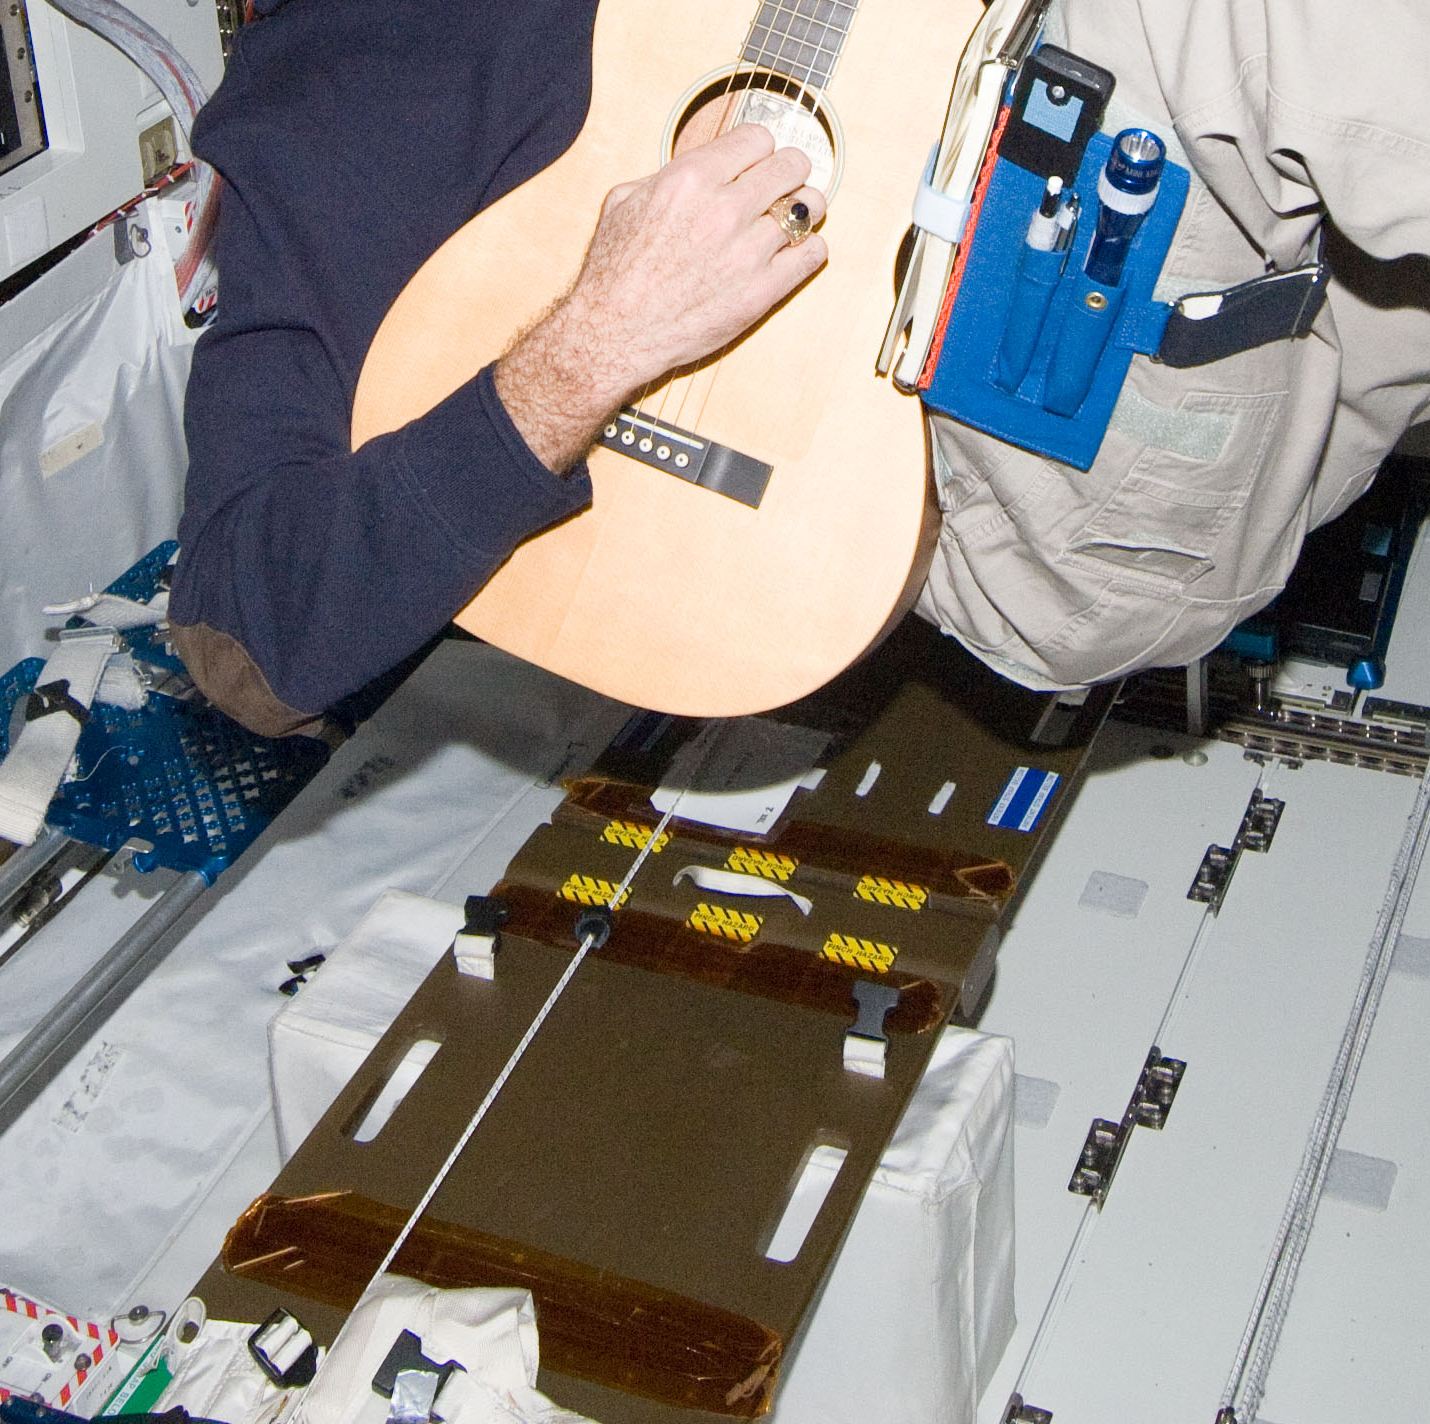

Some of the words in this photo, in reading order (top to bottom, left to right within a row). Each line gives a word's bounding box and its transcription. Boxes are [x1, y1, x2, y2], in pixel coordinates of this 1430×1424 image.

[731, 854, 764, 868] HAZARD
[765, 862, 794, 874] PINCH
[860, 882, 895, 896] HAZARD
[895, 891, 924, 903] PINCH
[694, 911, 721, 924] PINCH
[722, 918, 755, 932] HAZARD
[827, 942, 854, 955] PINCH
[855, 948, 891, 964] HAZARD
